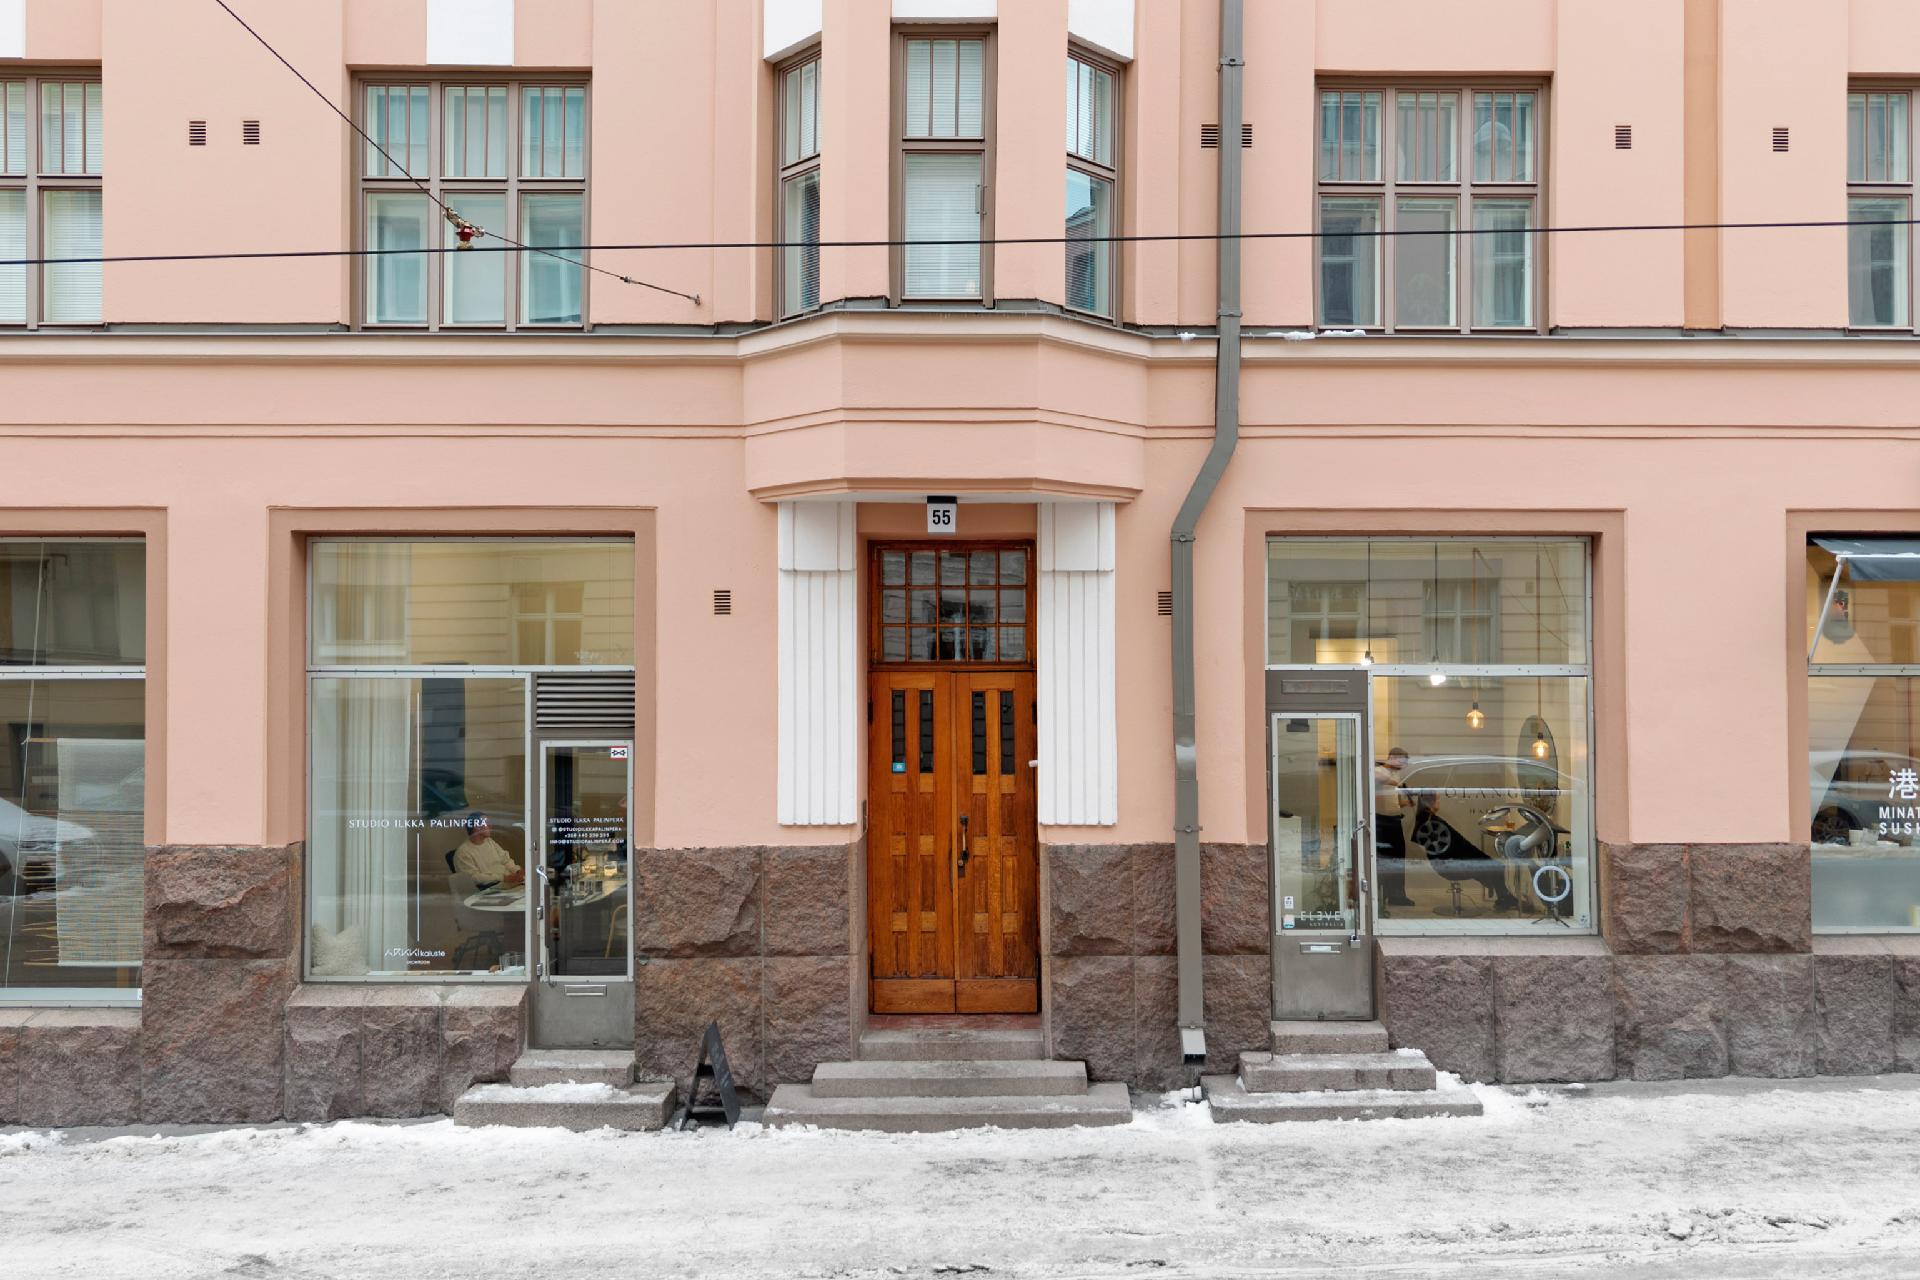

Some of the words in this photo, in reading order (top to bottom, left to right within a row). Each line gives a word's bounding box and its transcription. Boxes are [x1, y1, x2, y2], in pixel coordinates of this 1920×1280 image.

[932, 509, 951, 525] 55
[1888, 767, 1919, 799] 港
[348, 819, 389, 829] STUDIO
[394, 818, 425, 828] ILKKA
[430, 817, 488, 828] PALINPERÄ
